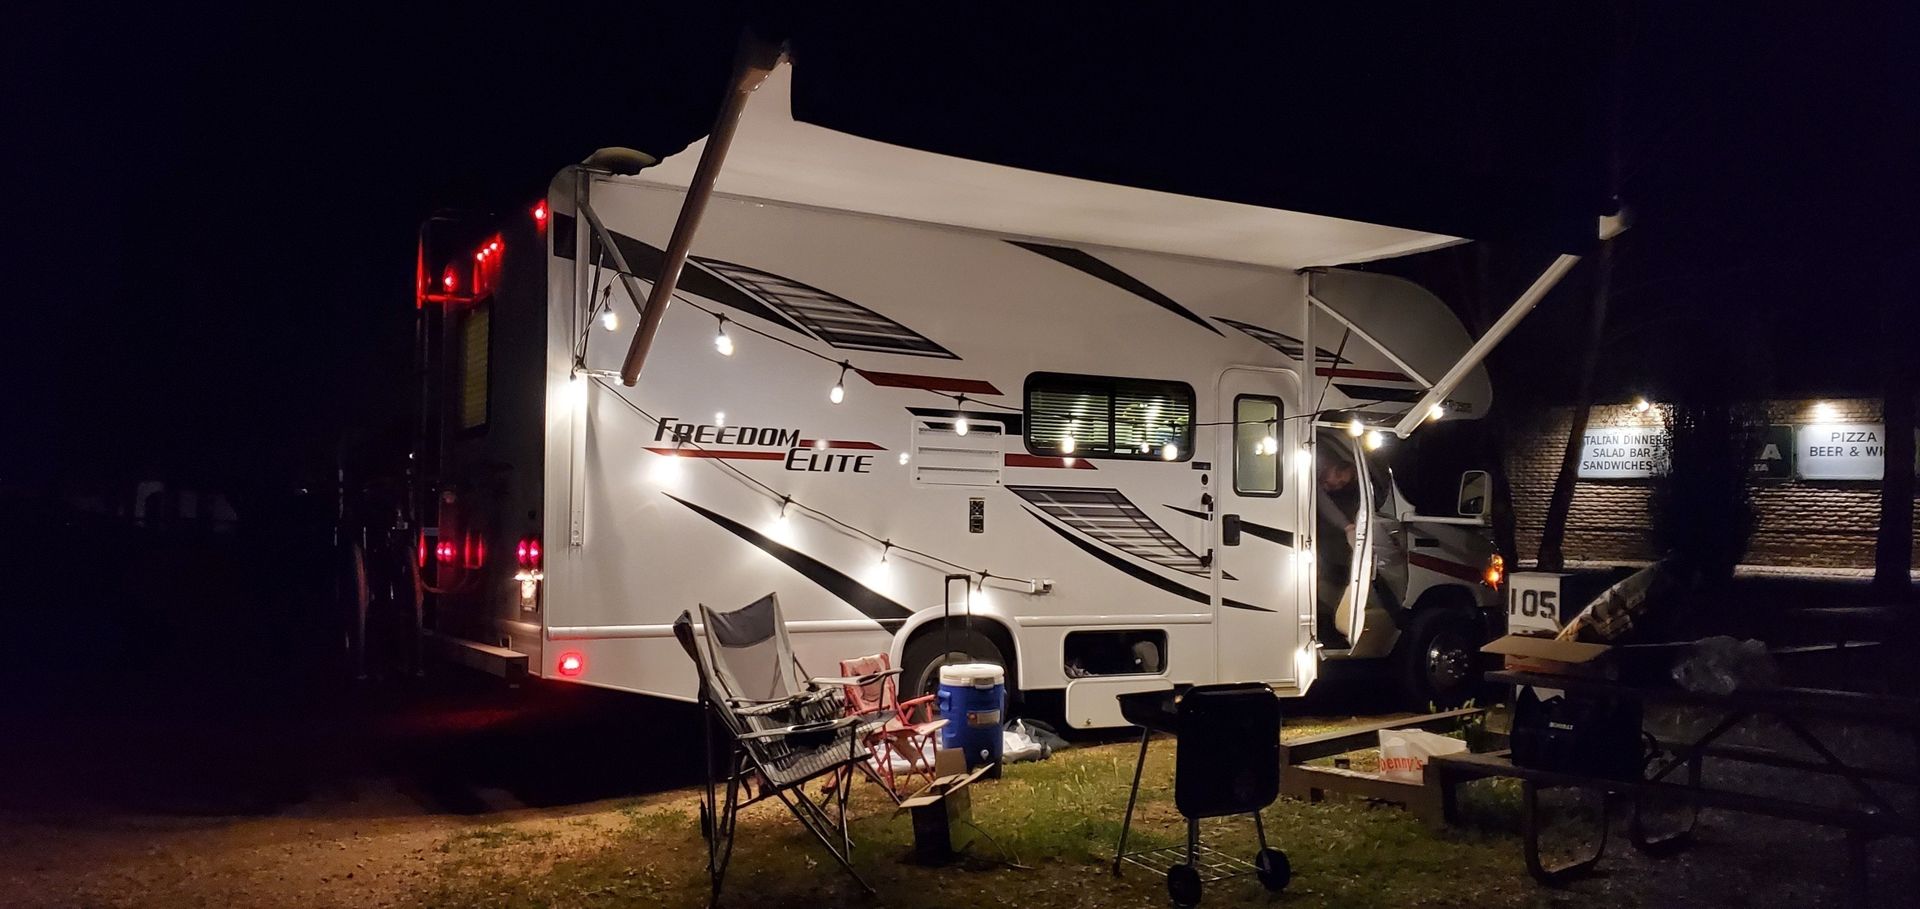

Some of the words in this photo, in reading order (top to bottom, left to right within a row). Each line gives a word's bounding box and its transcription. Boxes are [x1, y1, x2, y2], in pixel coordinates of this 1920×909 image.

[654, 417, 801, 447] FREEDOM
[1831, 432, 1877, 442] PIZZA
[1584, 435, 1619, 445] TALIAN
[1624, 435, 1667, 446] DINNER
[1593, 448, 1626, 458] SALAD
[1630, 448, 1651, 458] BAR
[1810, 446, 1843, 457] BEER
[1849, 446, 1860, 457] &
[1866, 446, 1884, 457] WI
[785, 448, 874, 473] ELITE
[1583, 461, 1653, 471] SANDWICHES
[1511, 588, 1557, 619] 105
